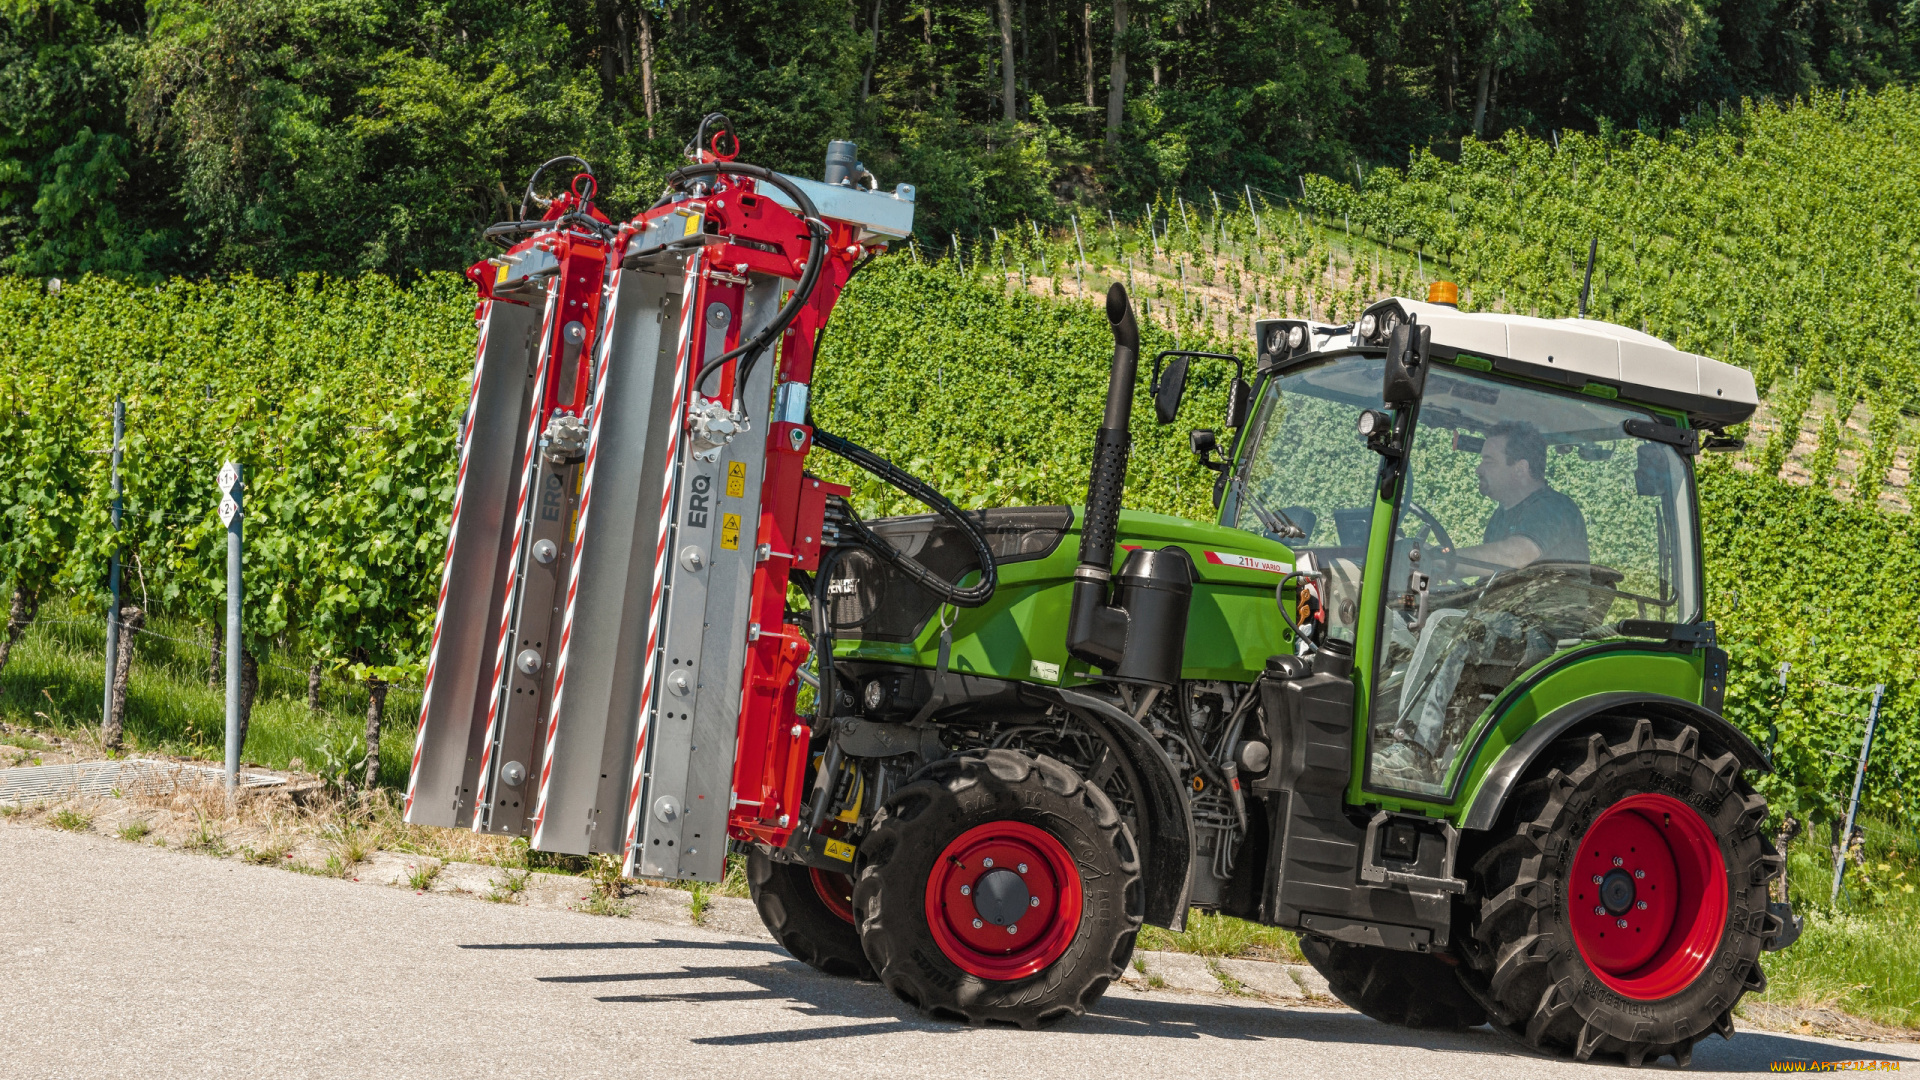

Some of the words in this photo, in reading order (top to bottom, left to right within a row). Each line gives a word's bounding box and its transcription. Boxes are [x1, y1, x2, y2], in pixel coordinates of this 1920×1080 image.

[225, 503, 230, 515] 2
[542, 473, 563, 522] ERO
[687, 475, 711, 529] ERO
[1261, 562, 1281, 571] VARIO
